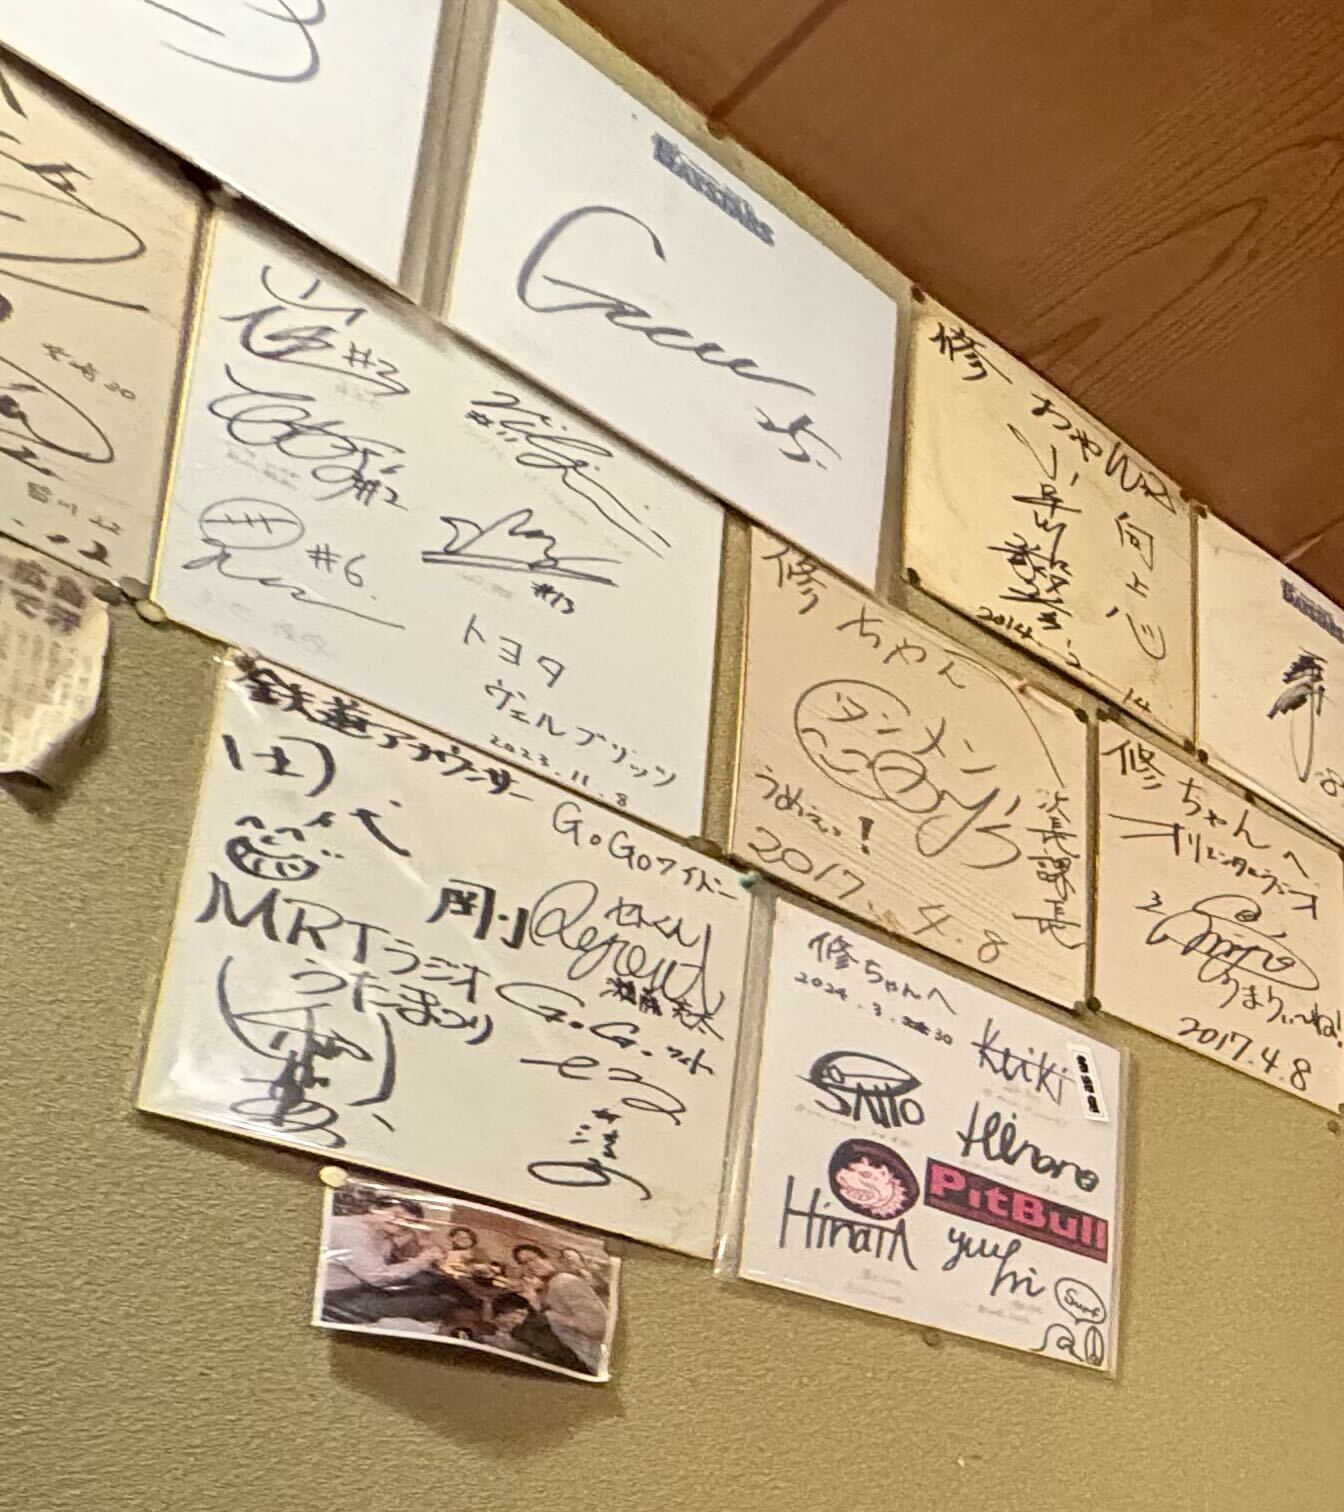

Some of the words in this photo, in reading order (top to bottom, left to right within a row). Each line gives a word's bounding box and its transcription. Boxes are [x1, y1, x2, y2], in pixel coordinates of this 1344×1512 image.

[305, 543, 368, 588] #6
[462, 614, 566, 690] トヨタ
[1026, 787, 1086, 951] 次長課長
[807, 930, 958, 1016] 修ちゃんへ
[1177, 1016, 1313, 1093] 2017.4.8
[930, 1163, 1110, 1252] PitBull
